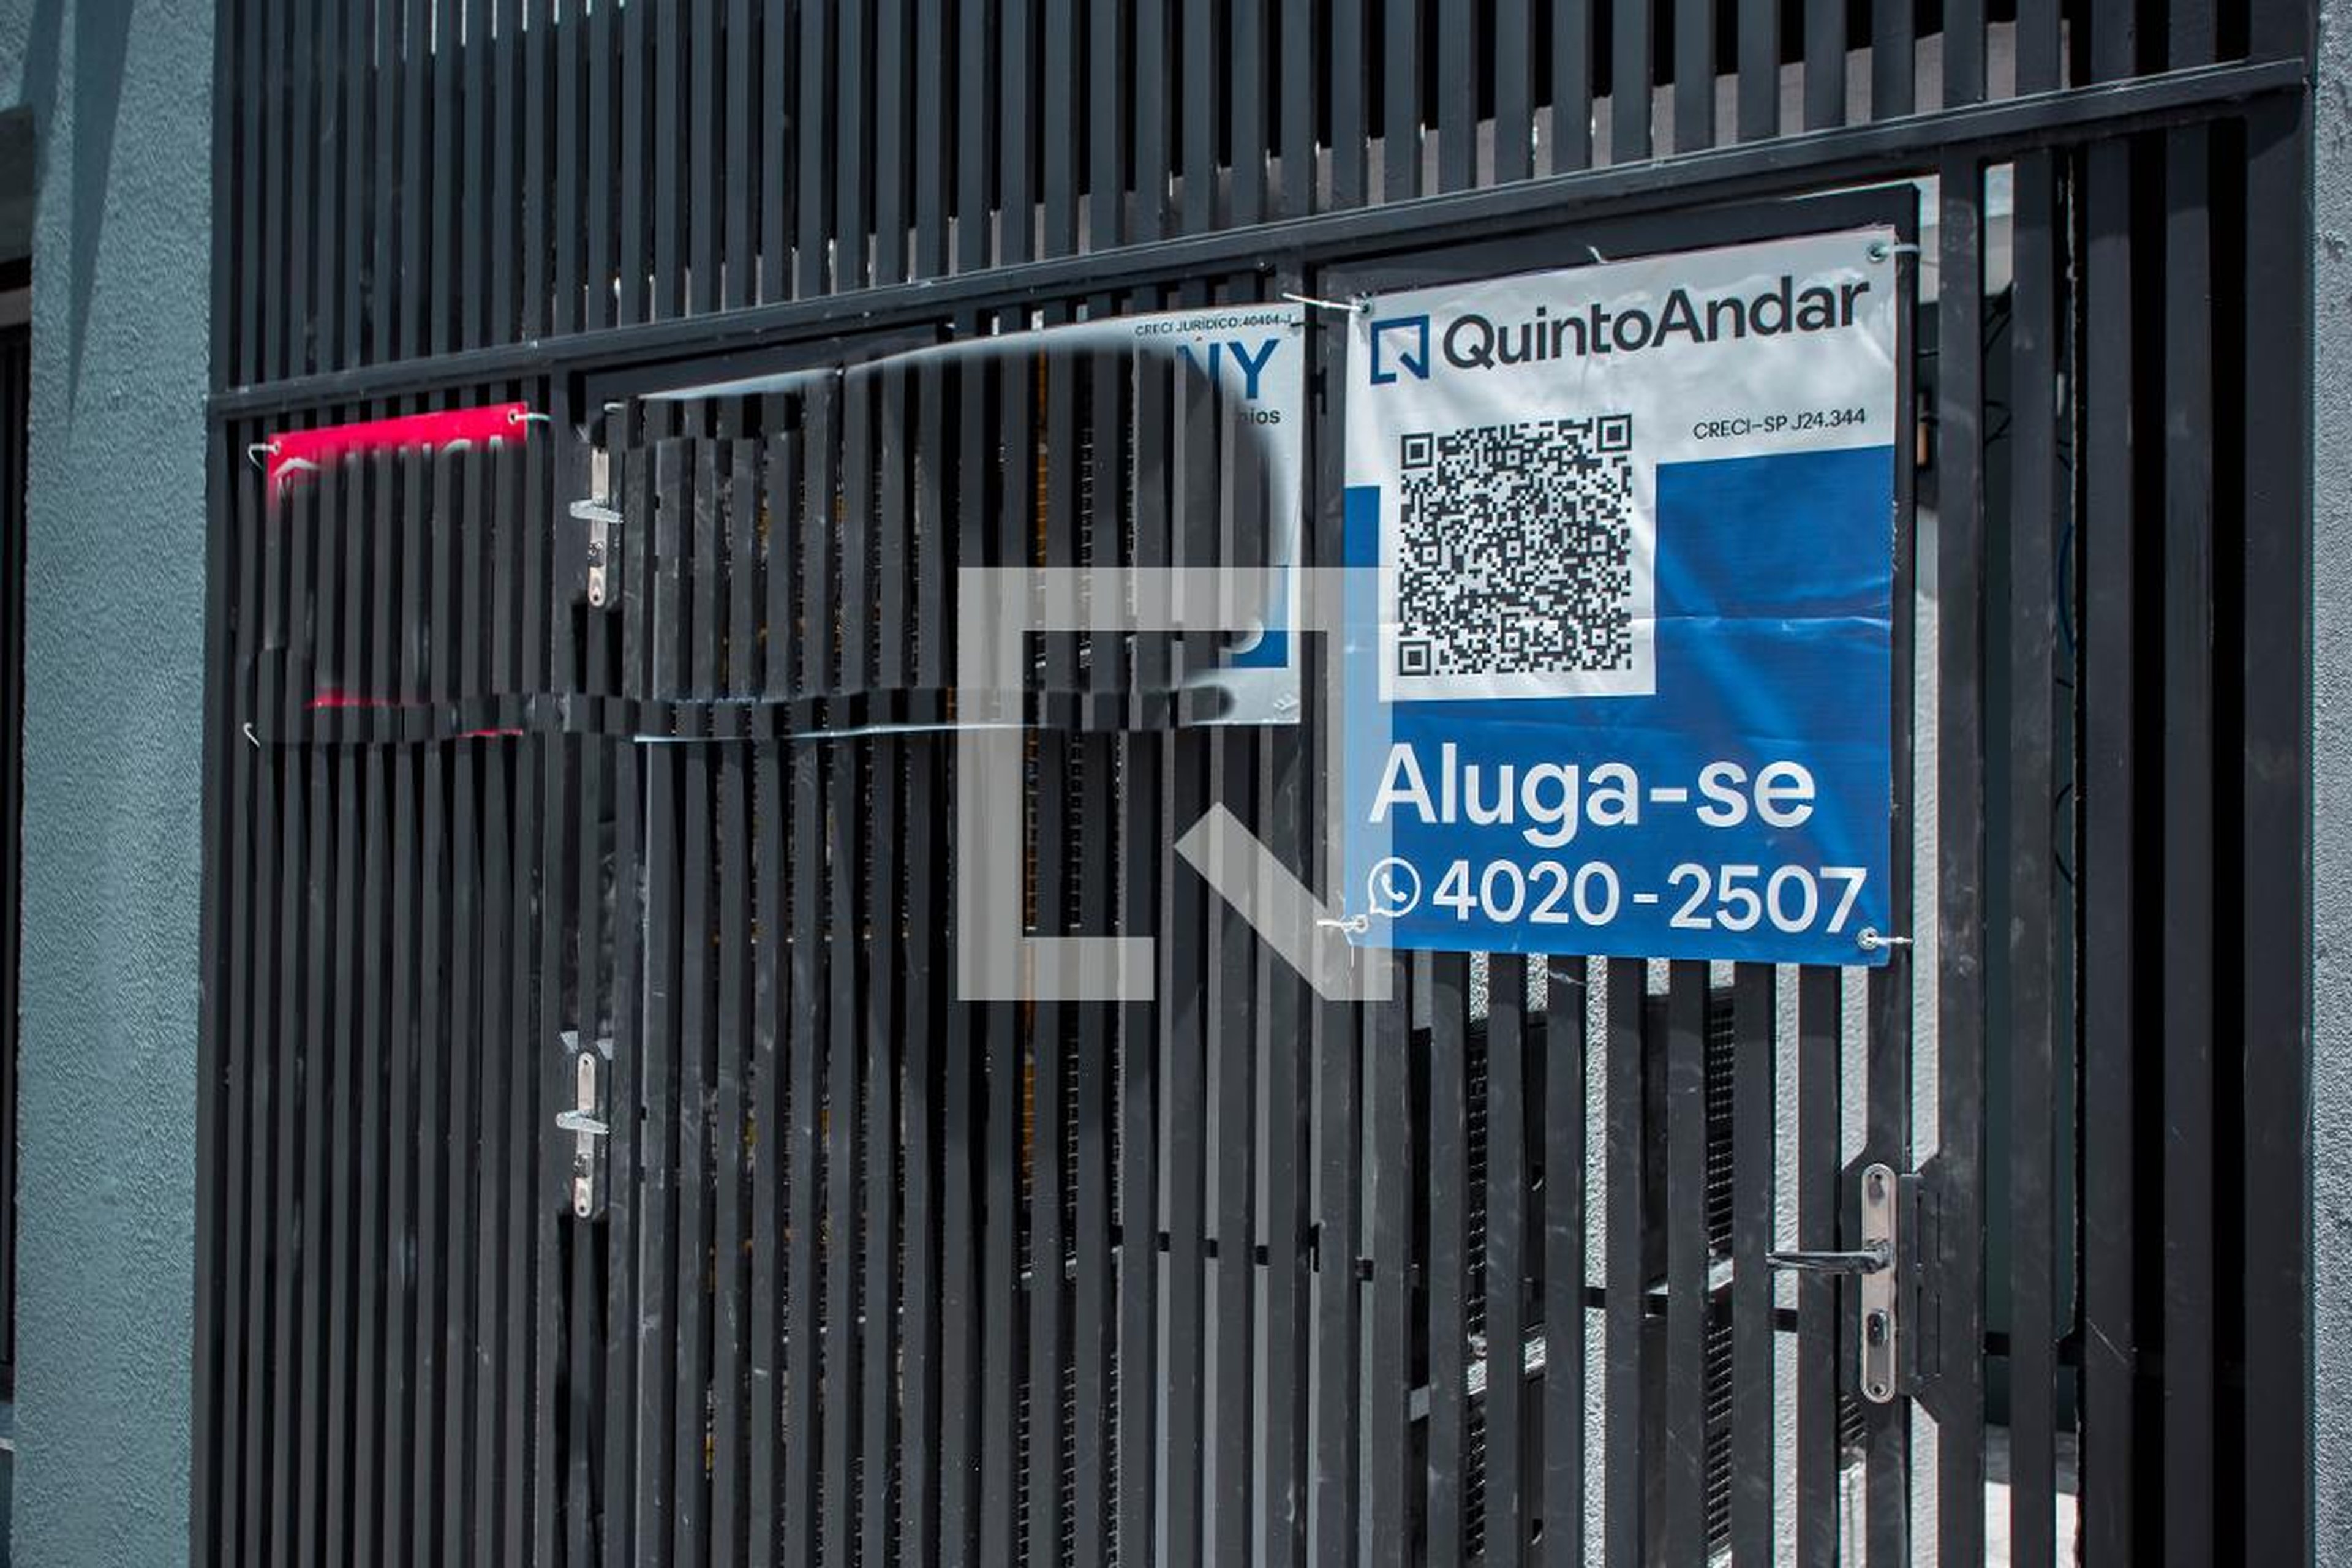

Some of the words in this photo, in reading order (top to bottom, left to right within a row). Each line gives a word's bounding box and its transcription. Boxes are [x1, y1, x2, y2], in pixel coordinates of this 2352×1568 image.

[1135, 321, 1173, 336] CRECI
[1443, 275, 1870, 370] QuintoAndar
[1693, 415, 1787, 439] CRECI-SP
[1791, 407, 1865, 430] J24.344
[1368, 742, 1815, 848] Aluga-se
